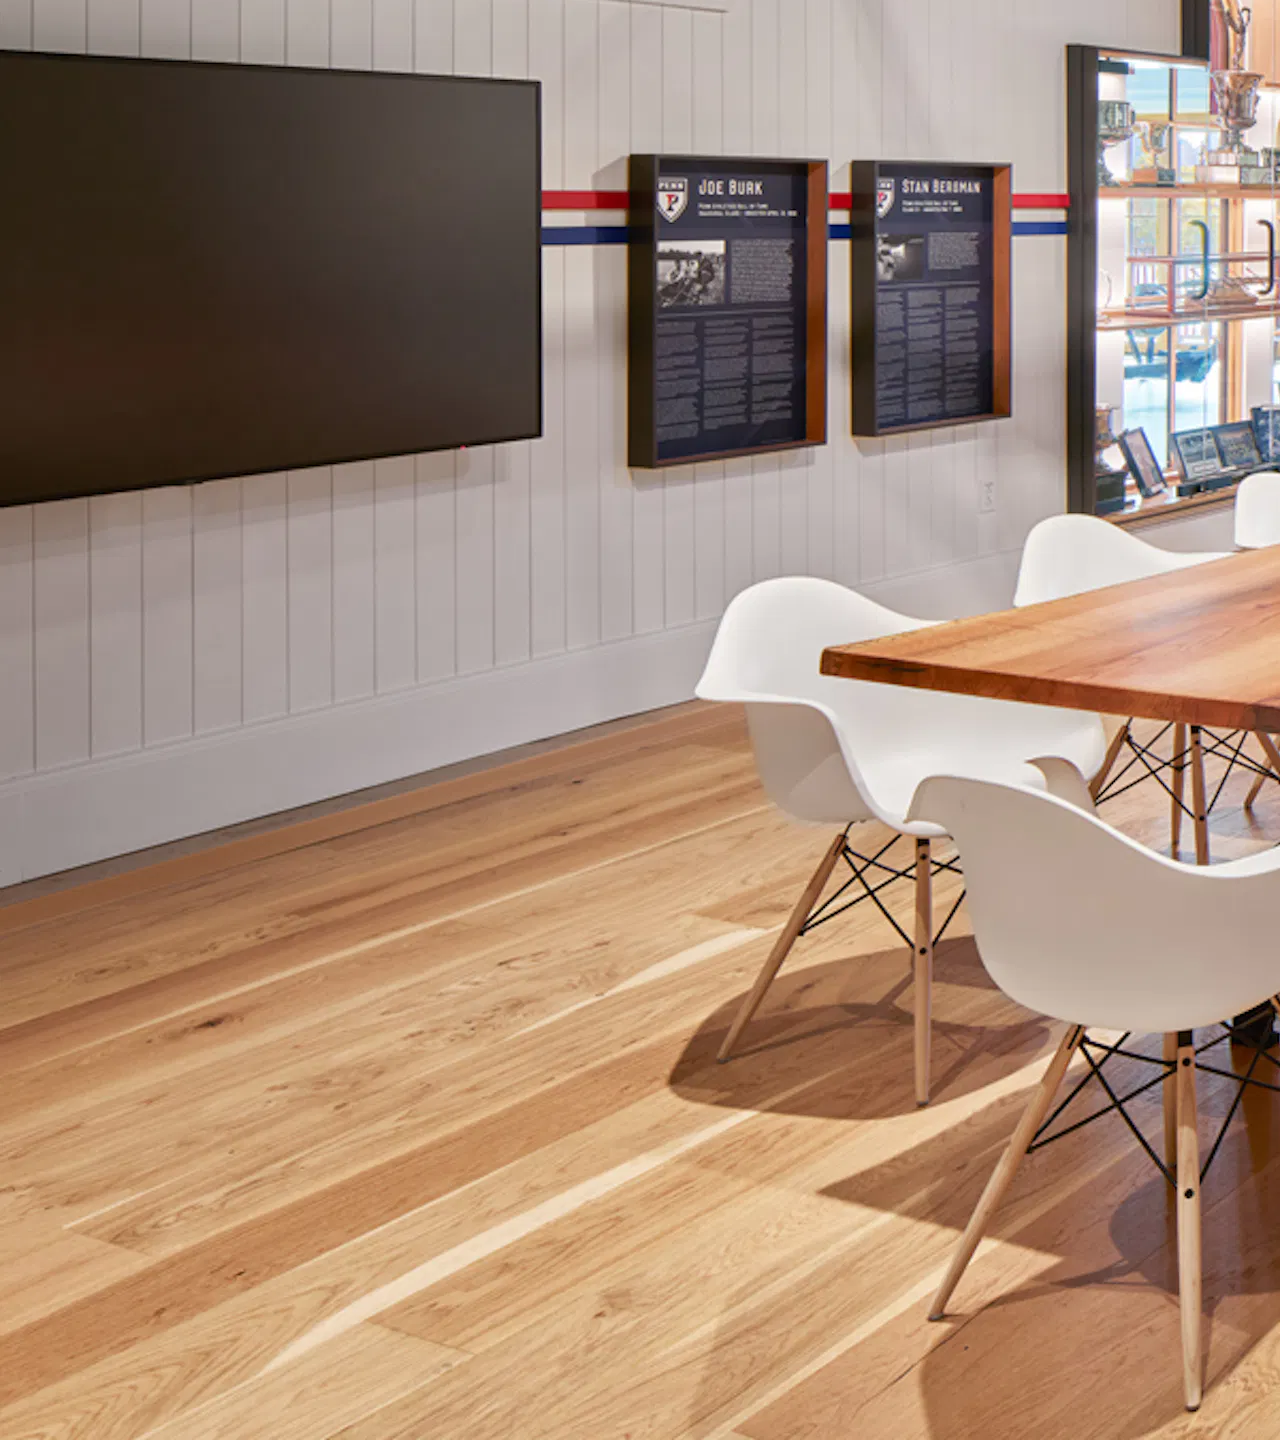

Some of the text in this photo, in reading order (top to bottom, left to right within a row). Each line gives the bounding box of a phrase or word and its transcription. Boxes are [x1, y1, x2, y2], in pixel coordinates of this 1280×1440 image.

[658, 182, 685, 190] PENN
[699, 179, 763, 195] JOE BURK
[902, 178, 929, 193] STAN
[933, 178, 981, 193] BERGMAN
